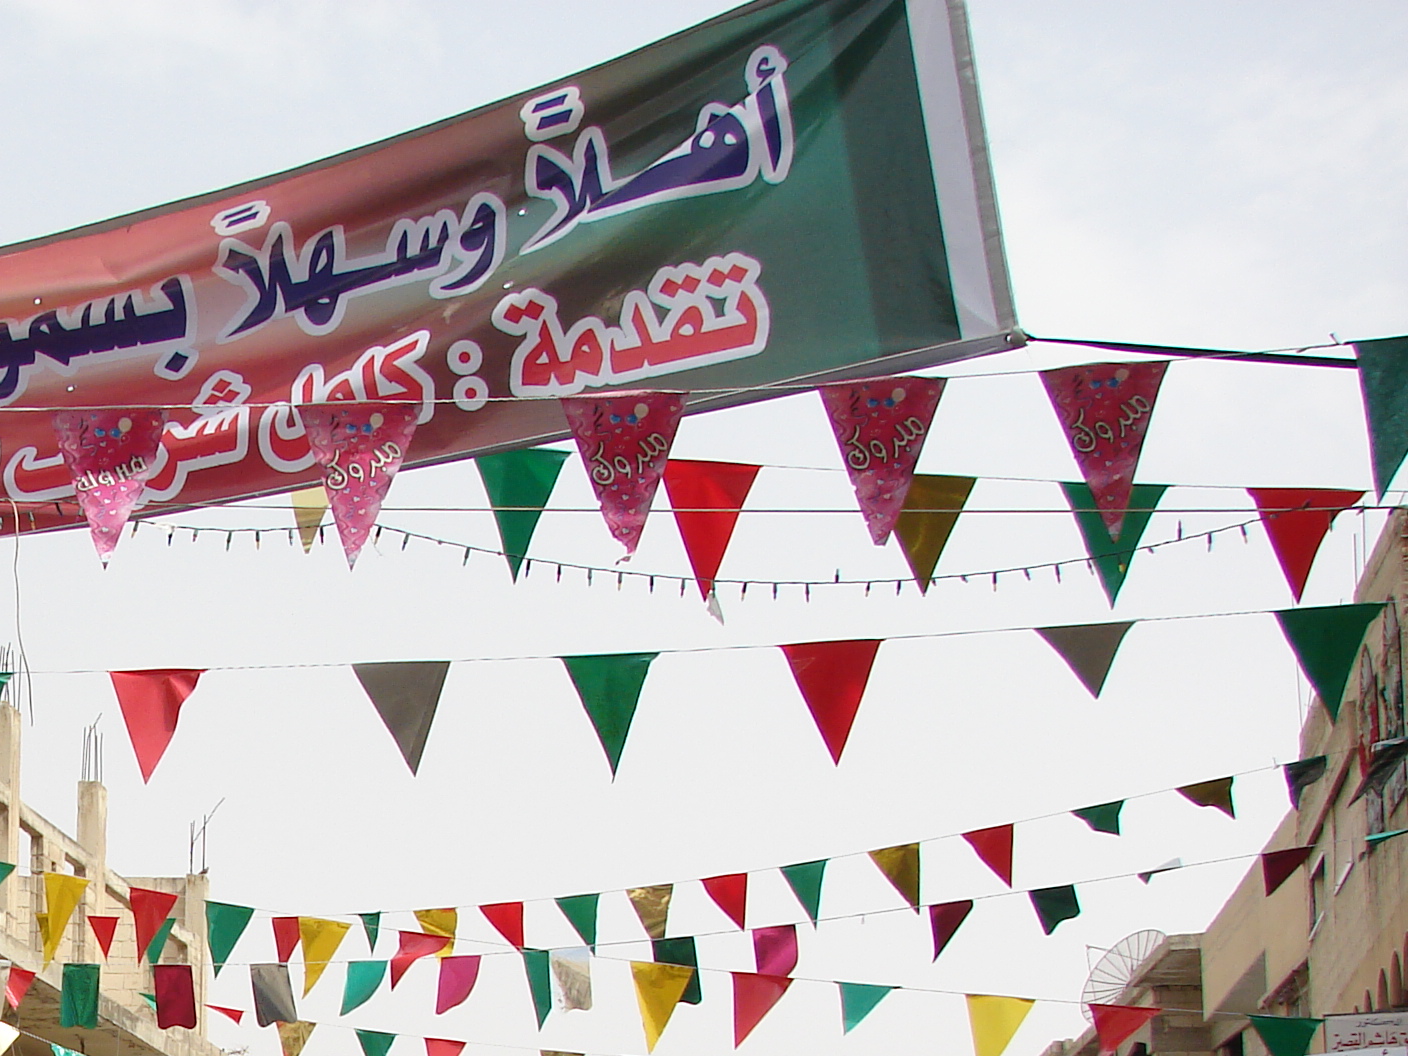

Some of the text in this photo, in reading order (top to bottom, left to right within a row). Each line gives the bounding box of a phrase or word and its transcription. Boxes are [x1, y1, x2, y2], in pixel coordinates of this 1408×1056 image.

[519, 45, 794, 256] أهلاً
[212, 192, 507, 344] وسهلاً
[492, 252, 770, 398] تقدمة
[325, 440, 402, 490] مبروك
[592, 432, 670, 487] مبروك
[846, 413, 927, 472] مبروك
